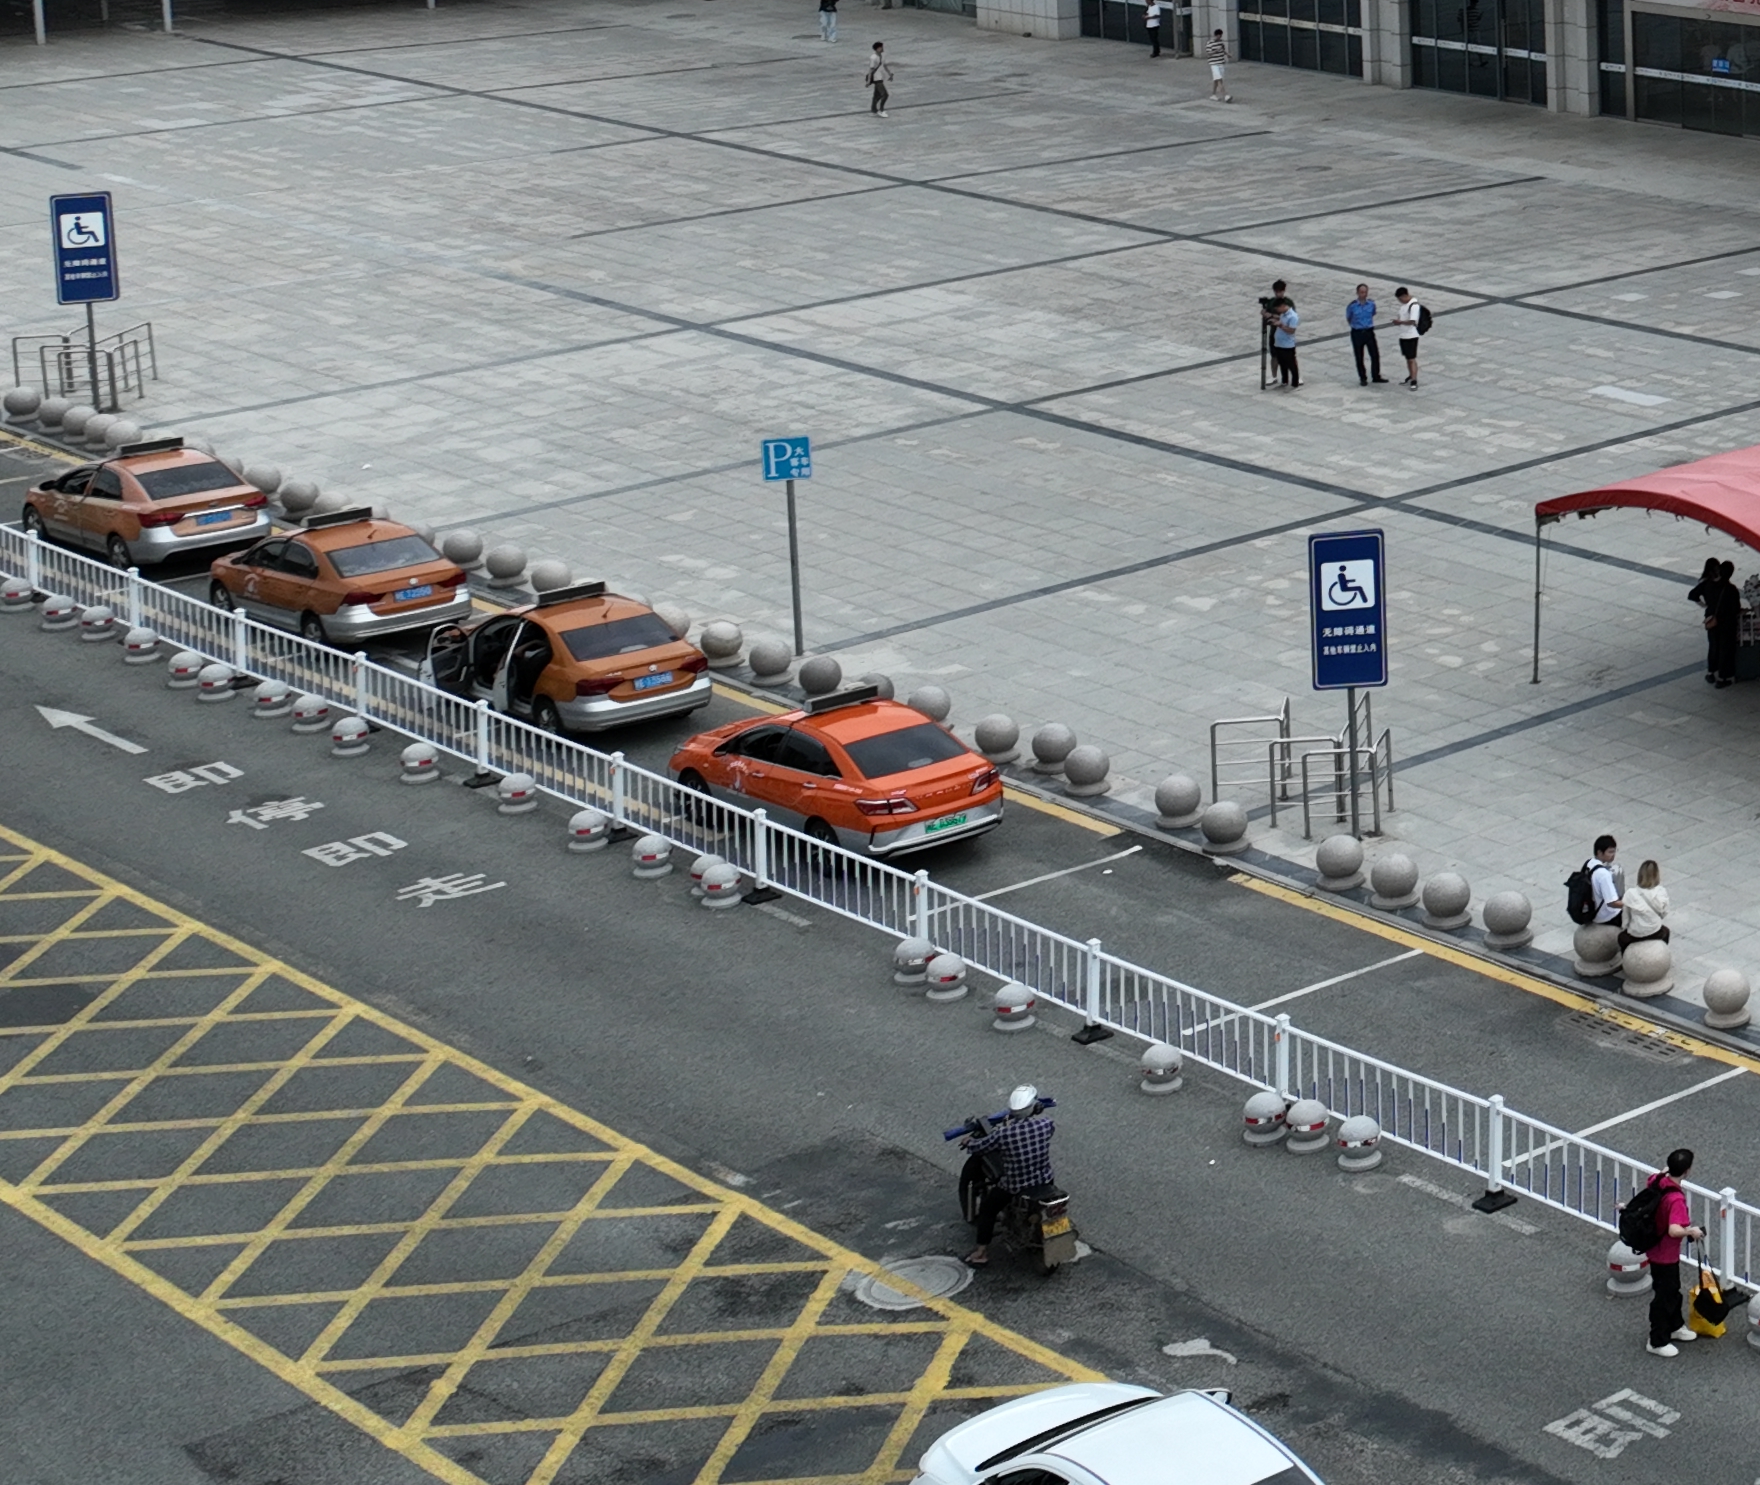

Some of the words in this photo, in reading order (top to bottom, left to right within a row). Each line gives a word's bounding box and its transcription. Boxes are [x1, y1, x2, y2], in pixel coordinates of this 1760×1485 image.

[765, 442, 792, 477] P
[1322, 624, 1376, 638] 无障碍通道
